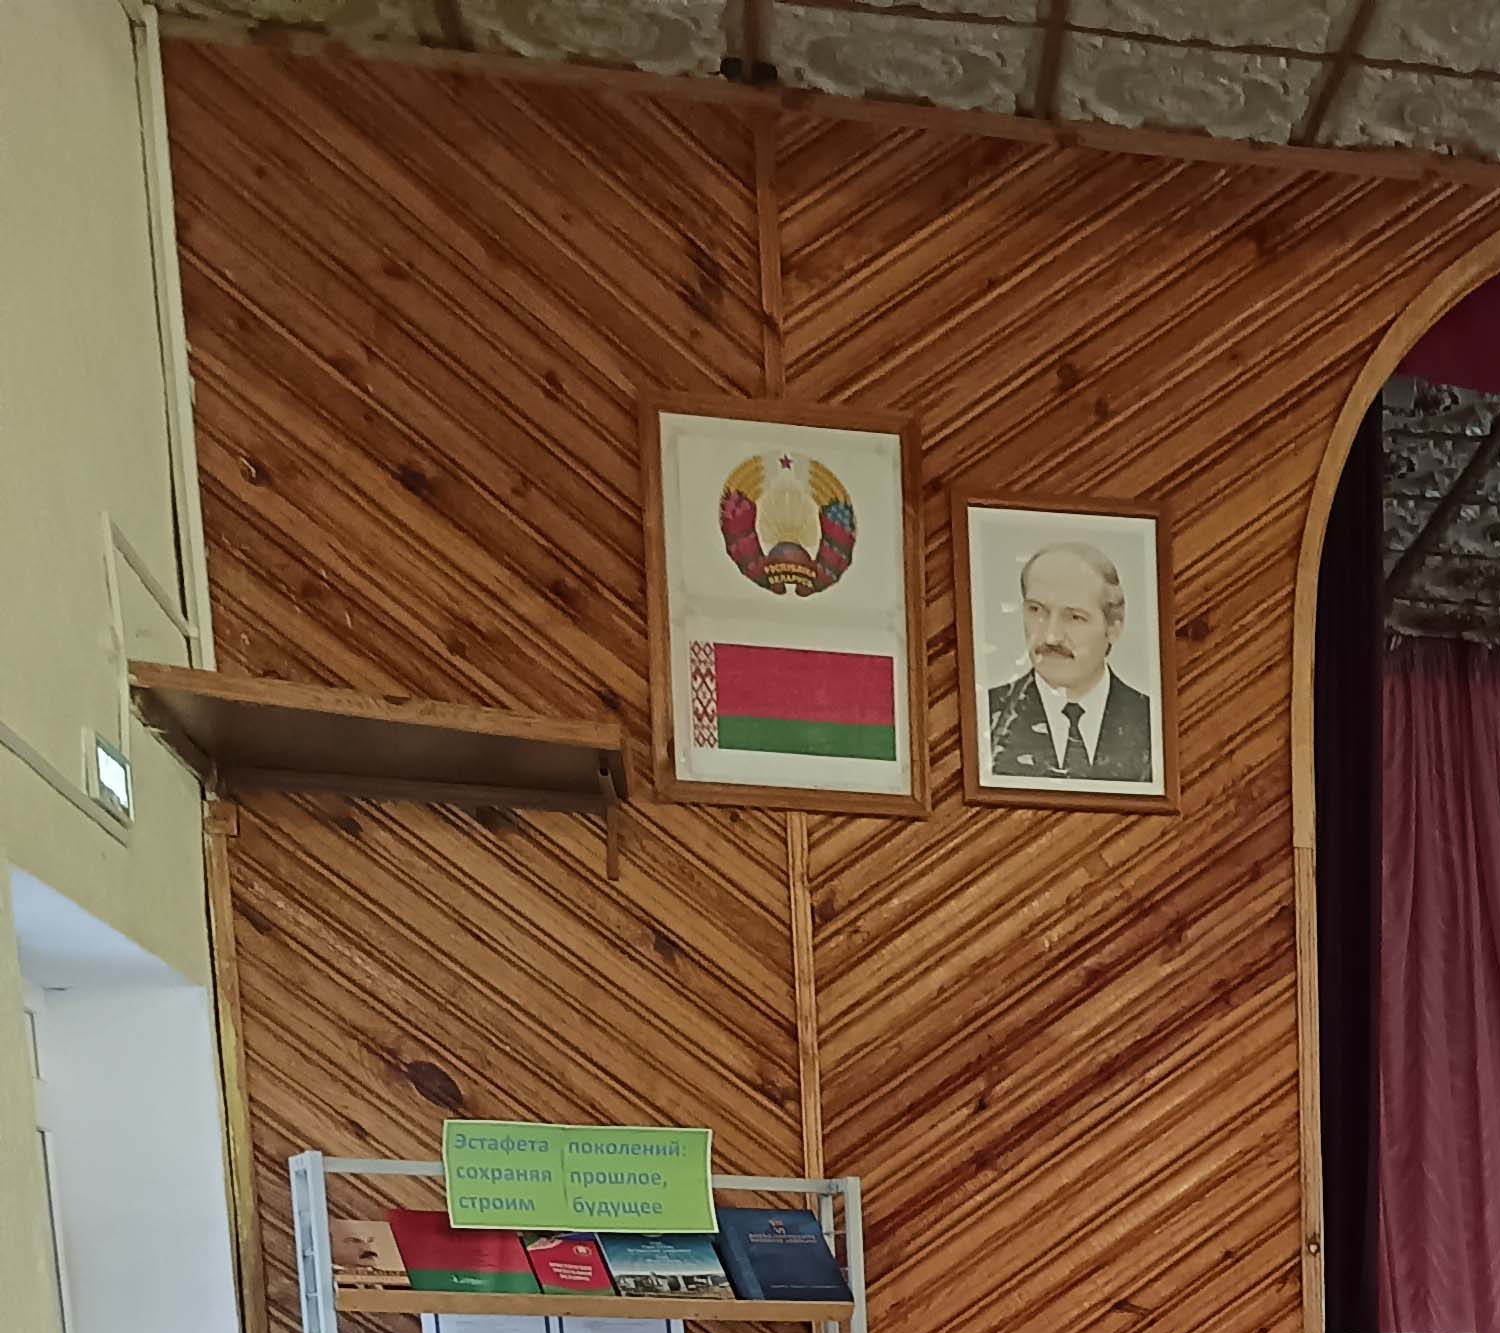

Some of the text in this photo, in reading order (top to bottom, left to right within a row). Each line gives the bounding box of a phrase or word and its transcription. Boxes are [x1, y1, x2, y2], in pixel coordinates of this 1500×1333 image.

[454, 1133, 687, 1157] Эстафета поколений:
[456, 1165, 668, 1188] сохраняя прошлое,
[459, 1196, 663, 1218] строим будущее
